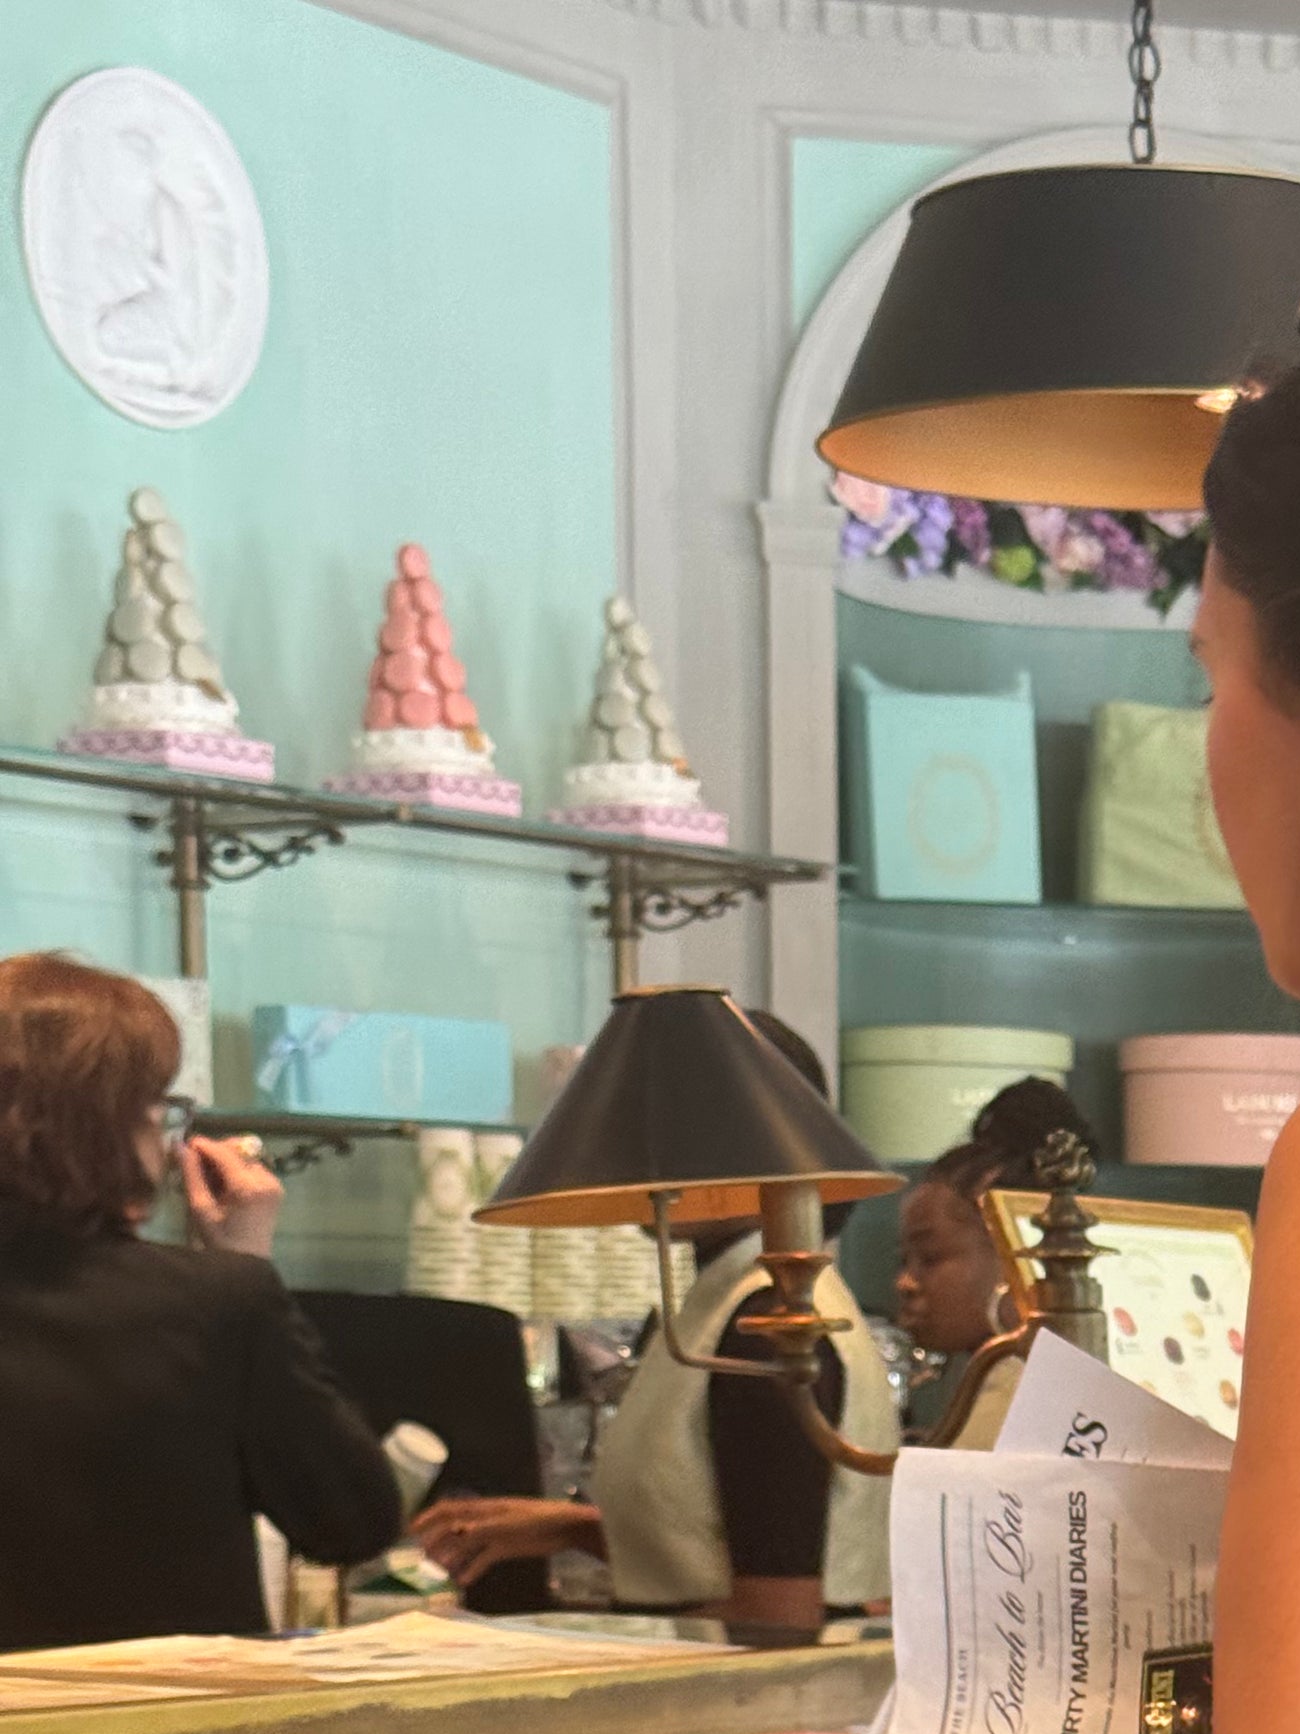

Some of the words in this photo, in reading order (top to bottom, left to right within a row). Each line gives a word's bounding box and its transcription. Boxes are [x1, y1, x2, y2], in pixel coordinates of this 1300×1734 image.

[983, 1489, 1034, 1584] Bar
[1067, 1490, 1088, 1584] DIARIES
[998, 1591, 1026, 1625] to
[1068, 1589, 1090, 1684] MARTINI
[955, 1649, 968, 1703] BEACH
